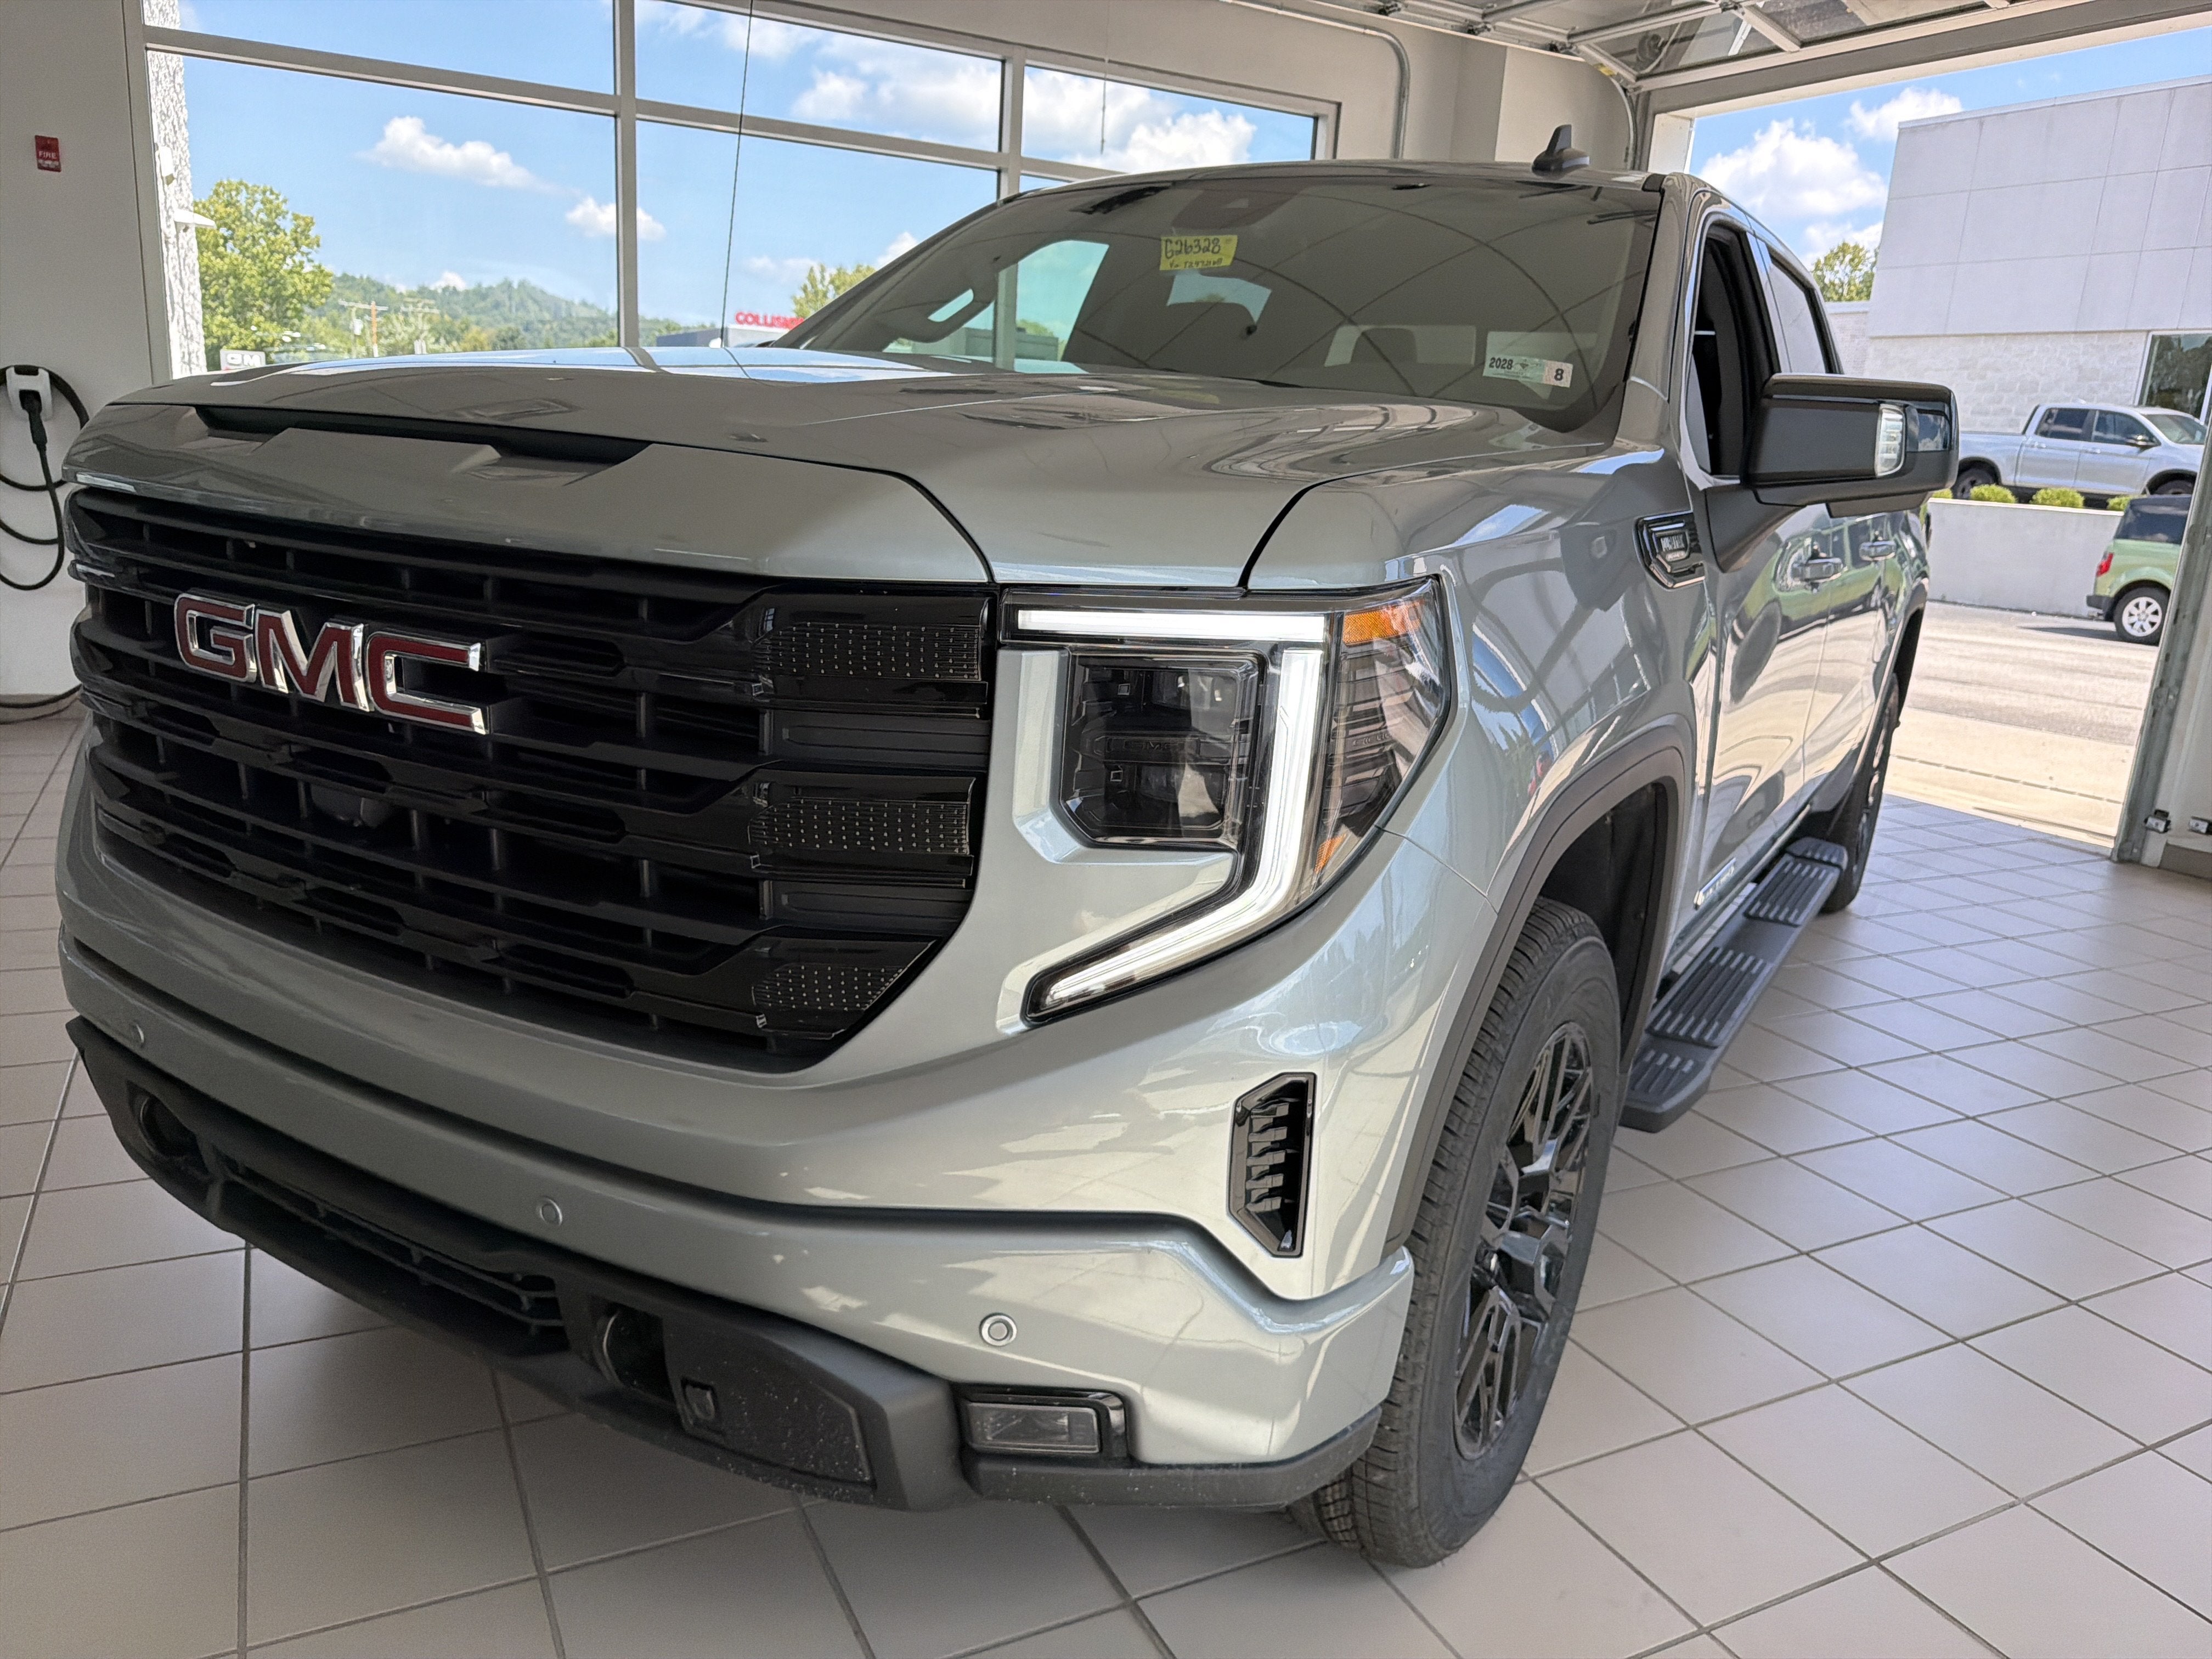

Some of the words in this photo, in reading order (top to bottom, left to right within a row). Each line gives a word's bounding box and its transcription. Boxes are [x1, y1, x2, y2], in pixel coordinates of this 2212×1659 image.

[1488, 357, 1514, 370] 2028
[1554, 368, 1564, 381] 8
[174, 593, 487, 735] GMC
